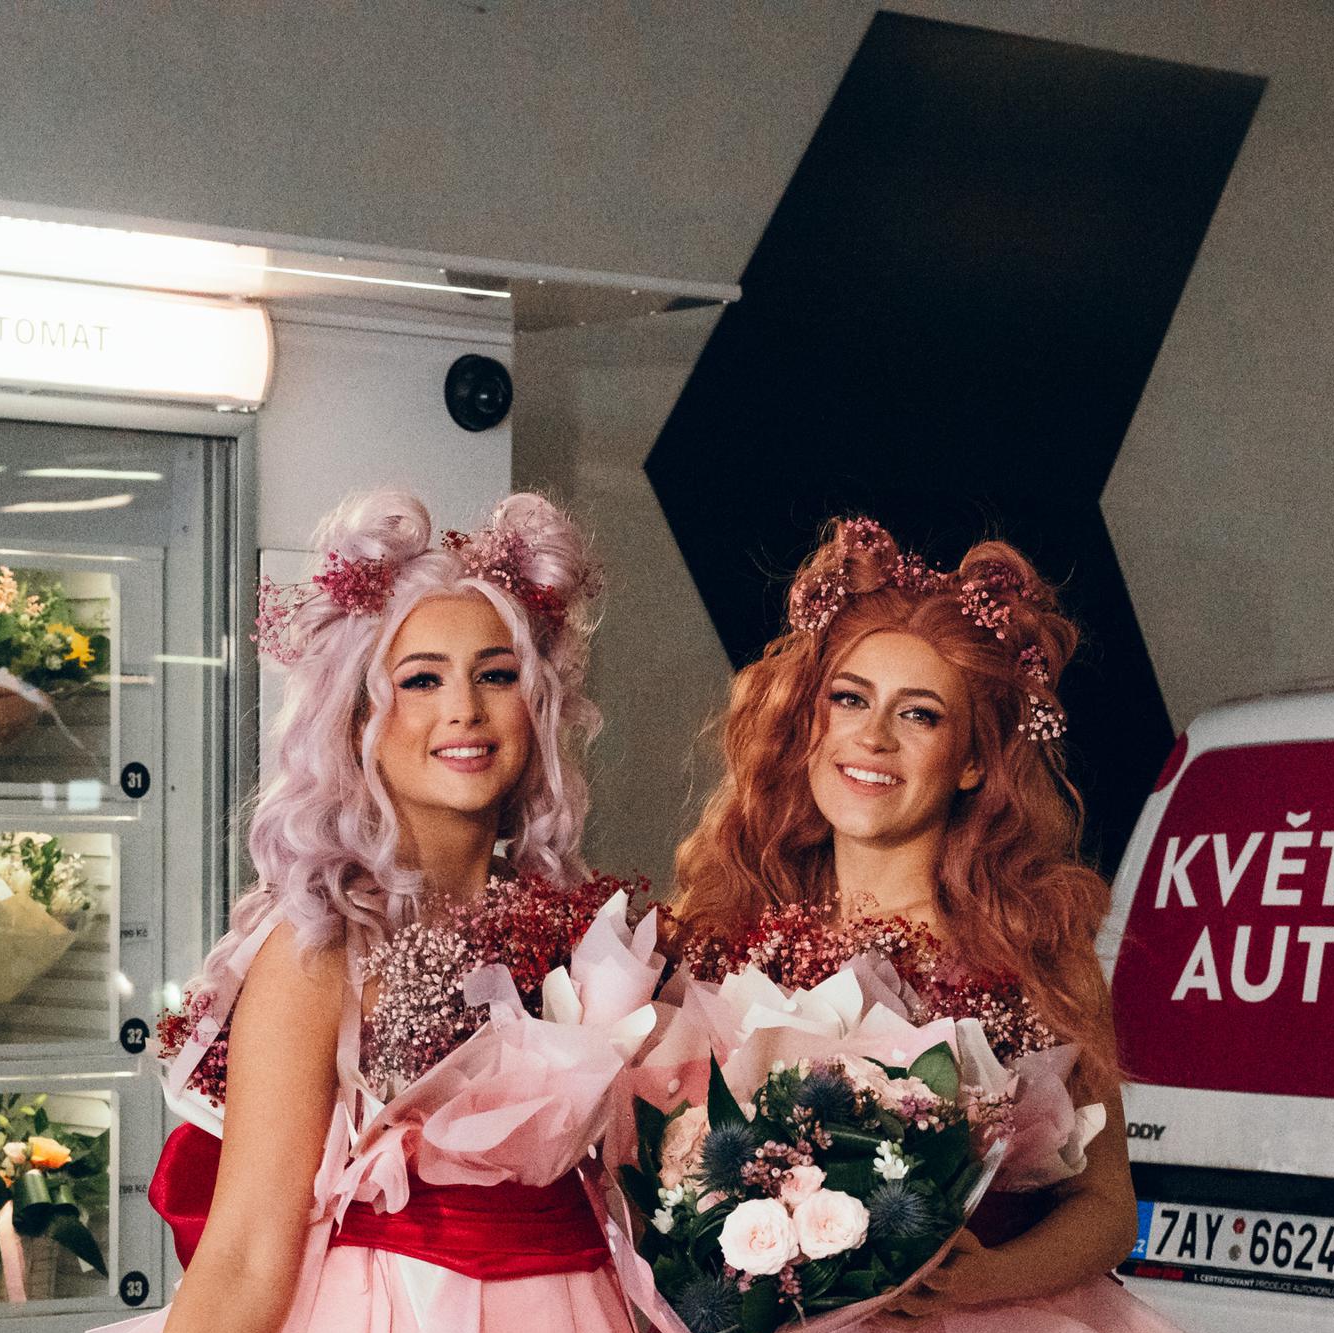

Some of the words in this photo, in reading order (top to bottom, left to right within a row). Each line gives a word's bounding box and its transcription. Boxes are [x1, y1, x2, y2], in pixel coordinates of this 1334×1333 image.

[128, 773, 143, 789] 31
[127, 1028, 143, 1044] 32
[1127, 1122, 1166, 1141] DDY
[1155, 1209, 1224, 1260] 7AY
[127, 1281, 142, 1297] 33
